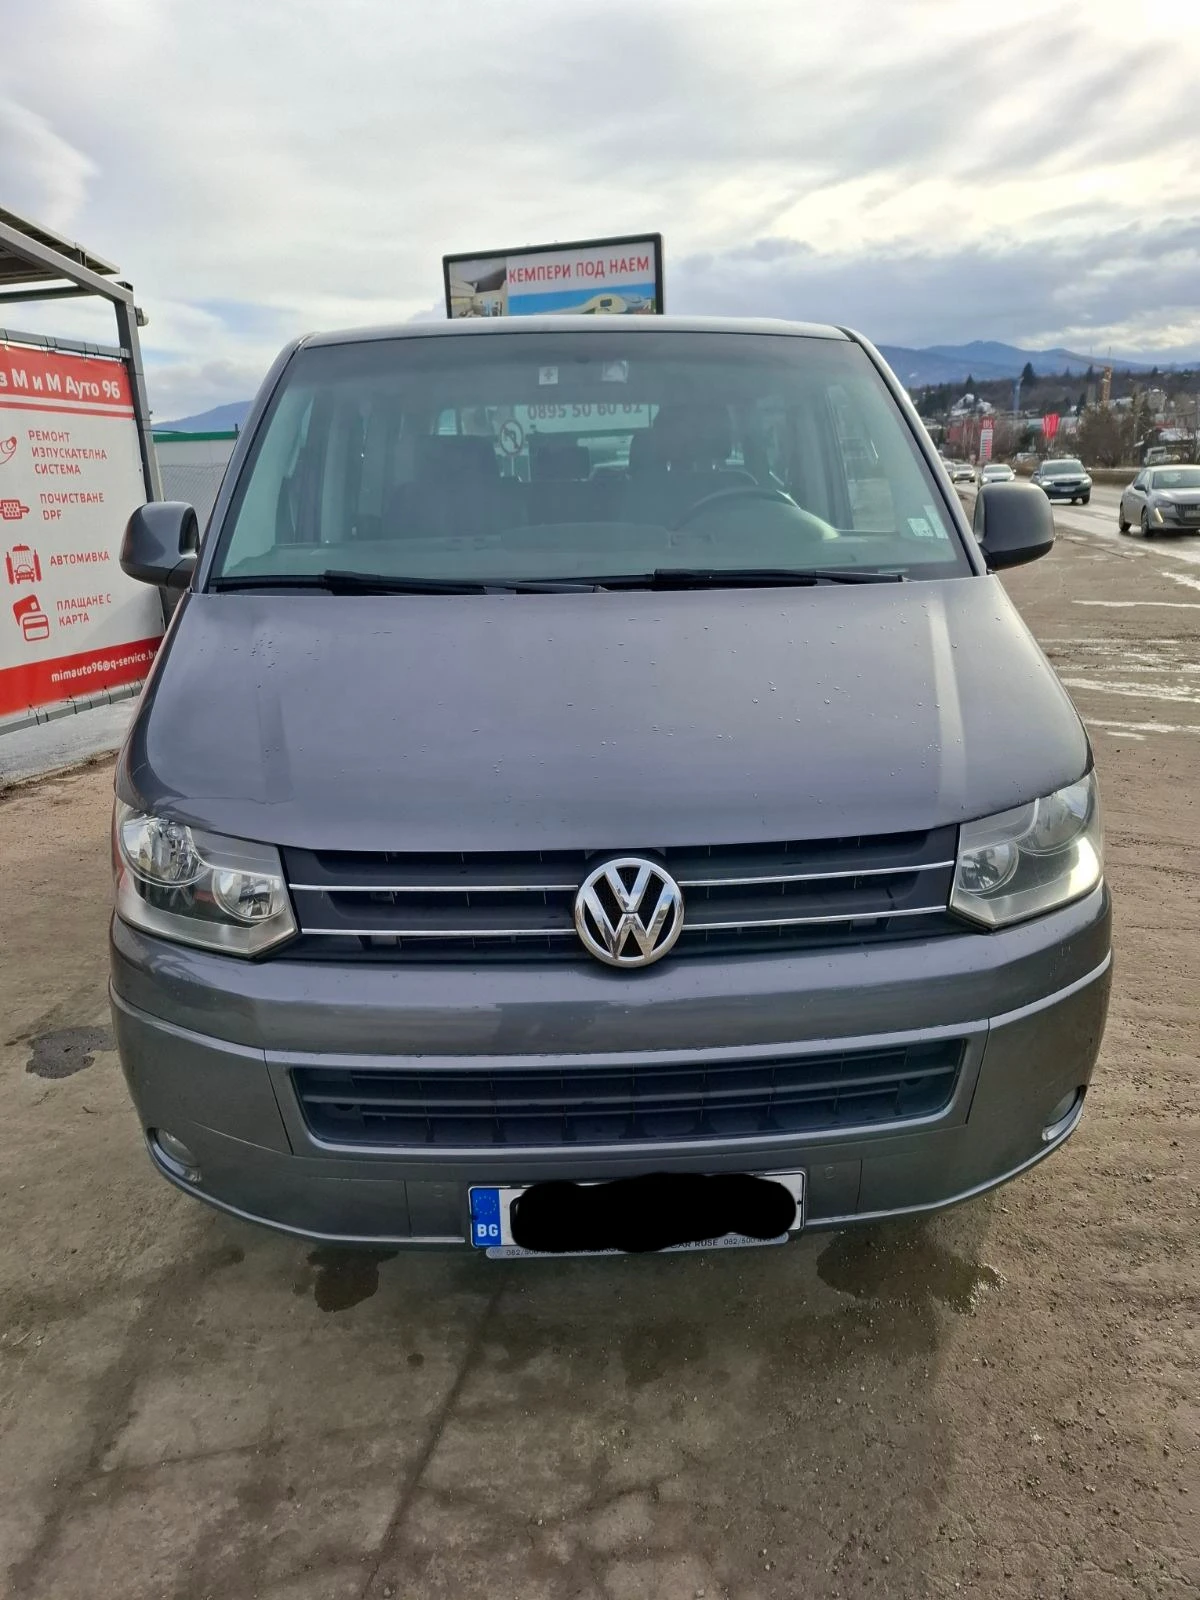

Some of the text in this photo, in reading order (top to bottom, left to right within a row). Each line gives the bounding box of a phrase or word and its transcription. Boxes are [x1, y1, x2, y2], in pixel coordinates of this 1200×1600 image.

[508, 256, 649, 284] КЕМПЕРИ ПОД НАЕМ
[32, 376, 43, 391] и
[65, 375, 100, 400] Ауто
[102, 379, 120, 400] 96
[28, 430, 70, 443] РЕМОНТ
[32, 447, 107, 460] ИЗПУСКАТЕЛНА
[35, 463, 81, 475] СИСТЕМА
[40, 492, 104, 504] ПОЧИСТВАНЕ
[43, 509, 62, 521] DPF
[50, 551, 110, 567] АВТОМИВКА
[56, 595, 105, 611] ПЛАЩАНЕ
[59, 612, 90, 626] КАРТА
[477, 1223, 499, 1237] BG
[695, 1239, 719, 1248] RUSE
